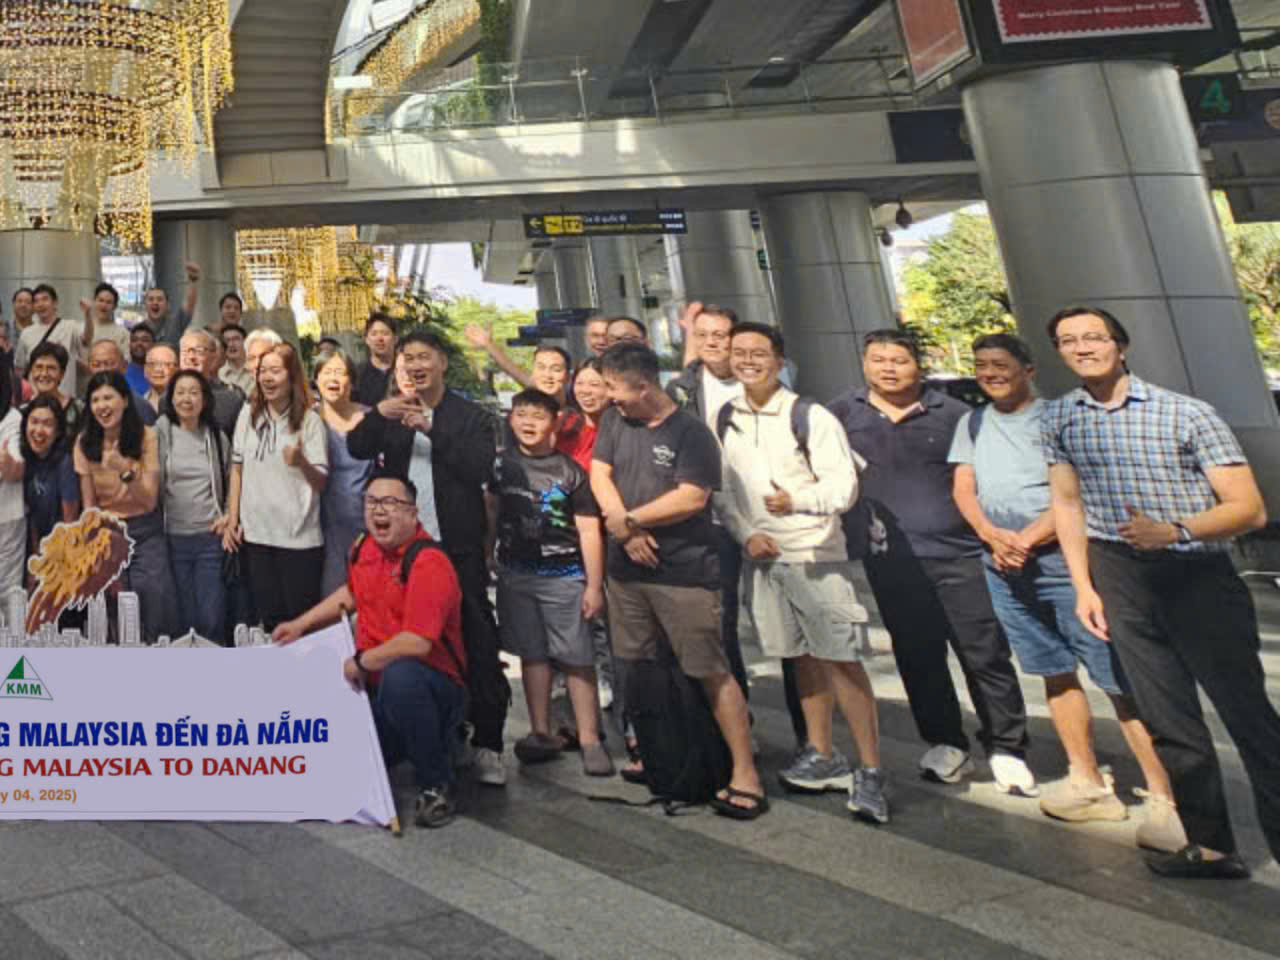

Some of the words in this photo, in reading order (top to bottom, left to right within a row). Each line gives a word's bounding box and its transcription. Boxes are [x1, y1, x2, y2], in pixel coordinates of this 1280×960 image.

[6, 683, 41, 695] KMM
[19, 721, 147, 747] MALAYSIA
[155, 716, 208, 746] ĐẾN
[216, 719, 249, 746] ĐÀ
[257, 710, 328, 744] NẴNG
[23, 758, 152, 776] MALAYSIA
[160, 758, 193, 776] TO
[202, 755, 306, 776] DANANG
[13, 789, 35, 802] 04,
[40, 789, 77, 803] 2025)
